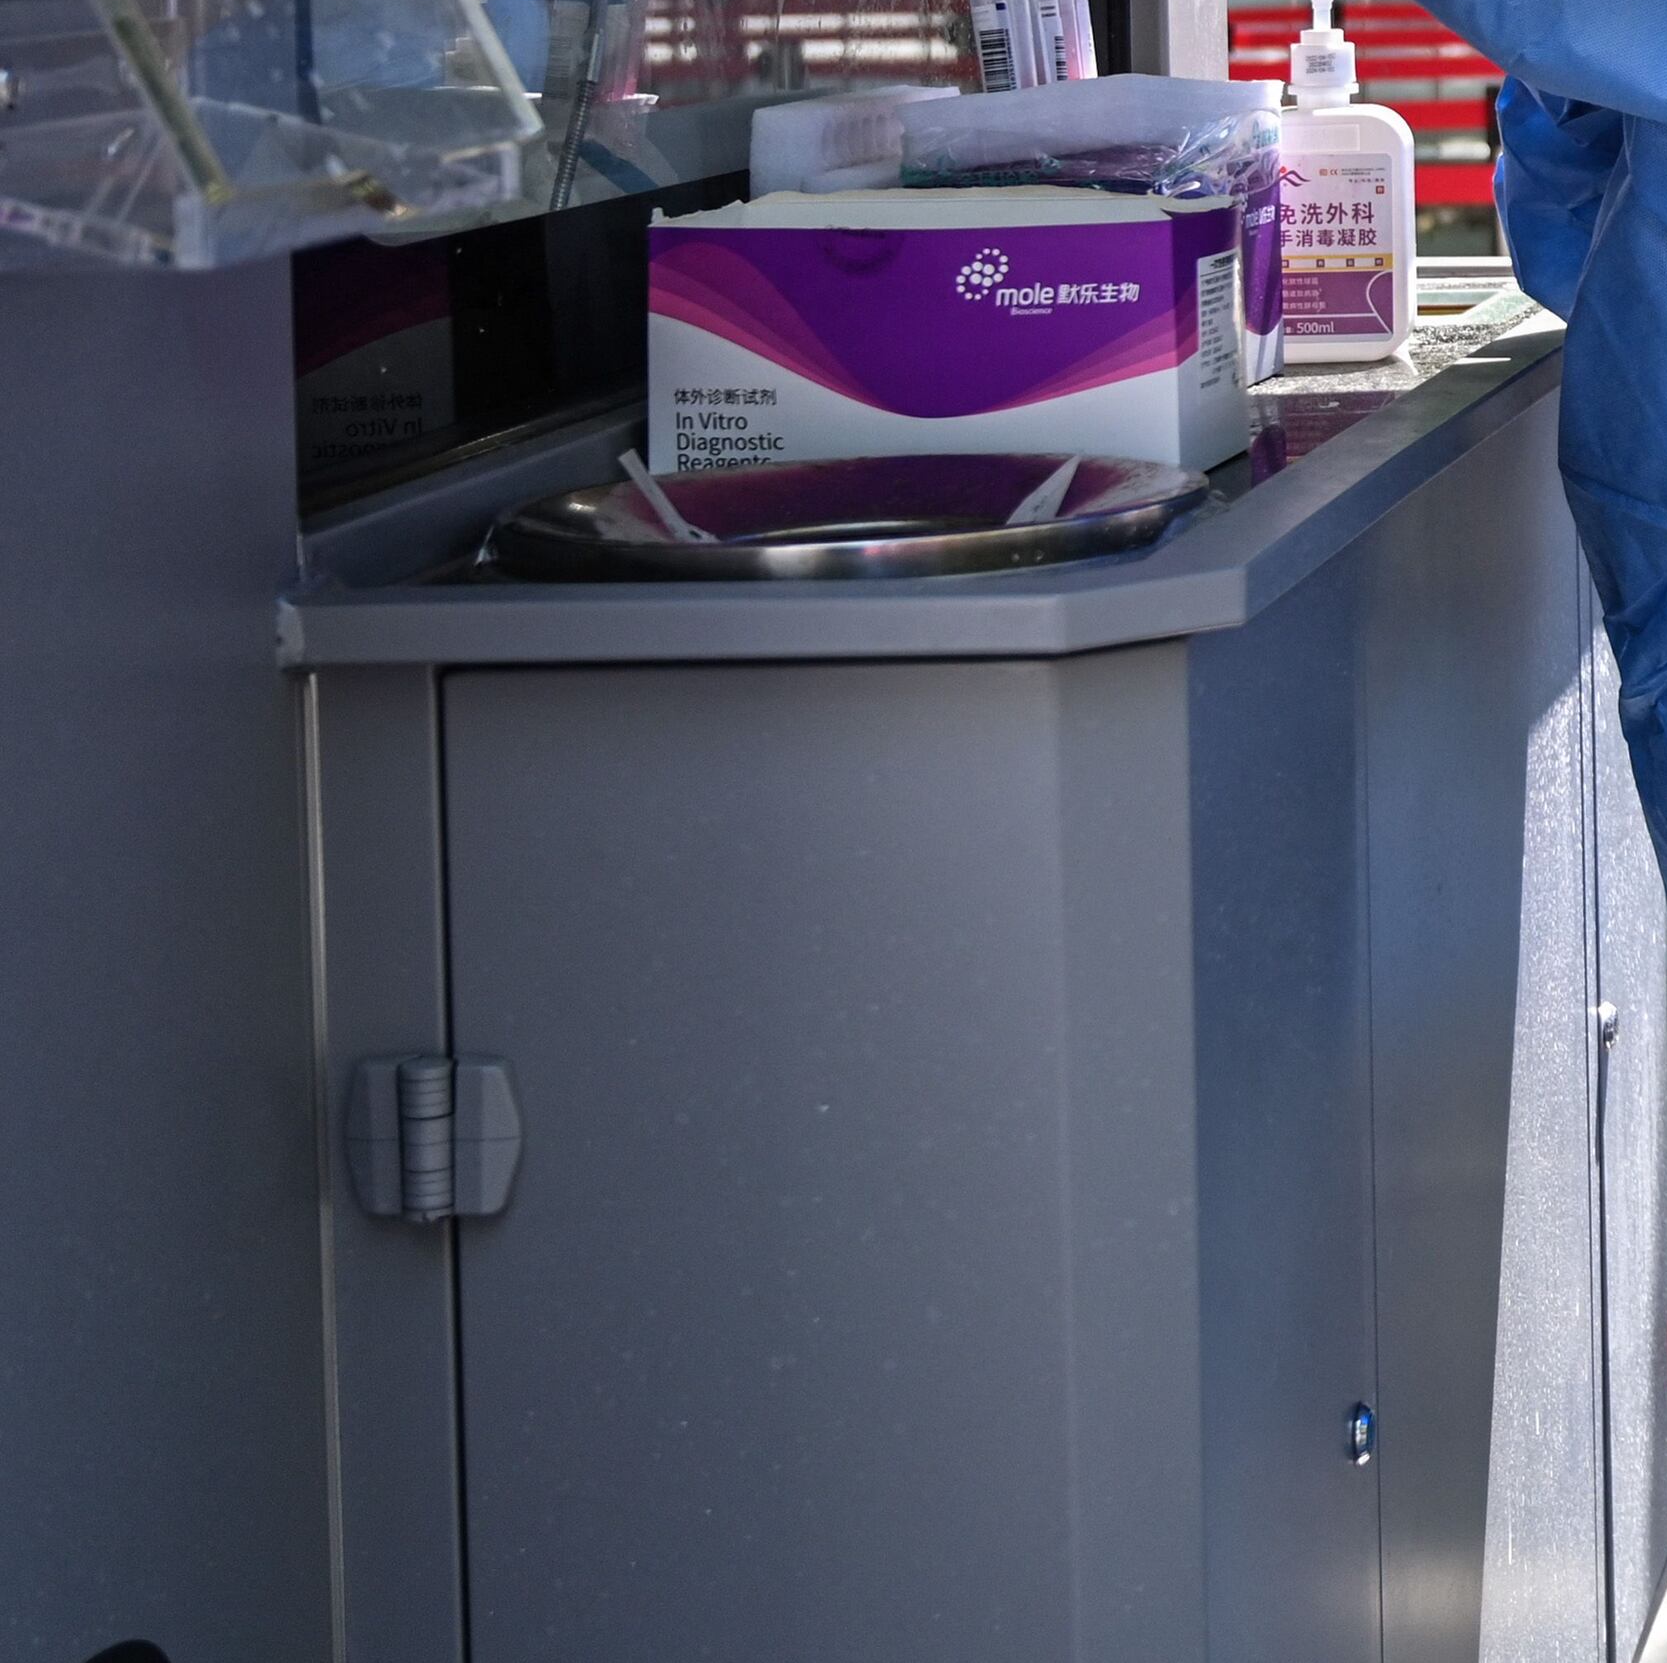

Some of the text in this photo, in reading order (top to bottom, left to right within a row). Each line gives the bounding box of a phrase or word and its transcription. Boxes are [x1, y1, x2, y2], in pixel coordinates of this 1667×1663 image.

[996, 282, 1140, 307] mole 默乐生物
[1296, 321, 1334, 335] 500ml
[674, 388, 777, 406] 体外诊断试剂
[676, 412, 748, 431] In Vitro
[676, 433, 785, 456] Diagnostic
